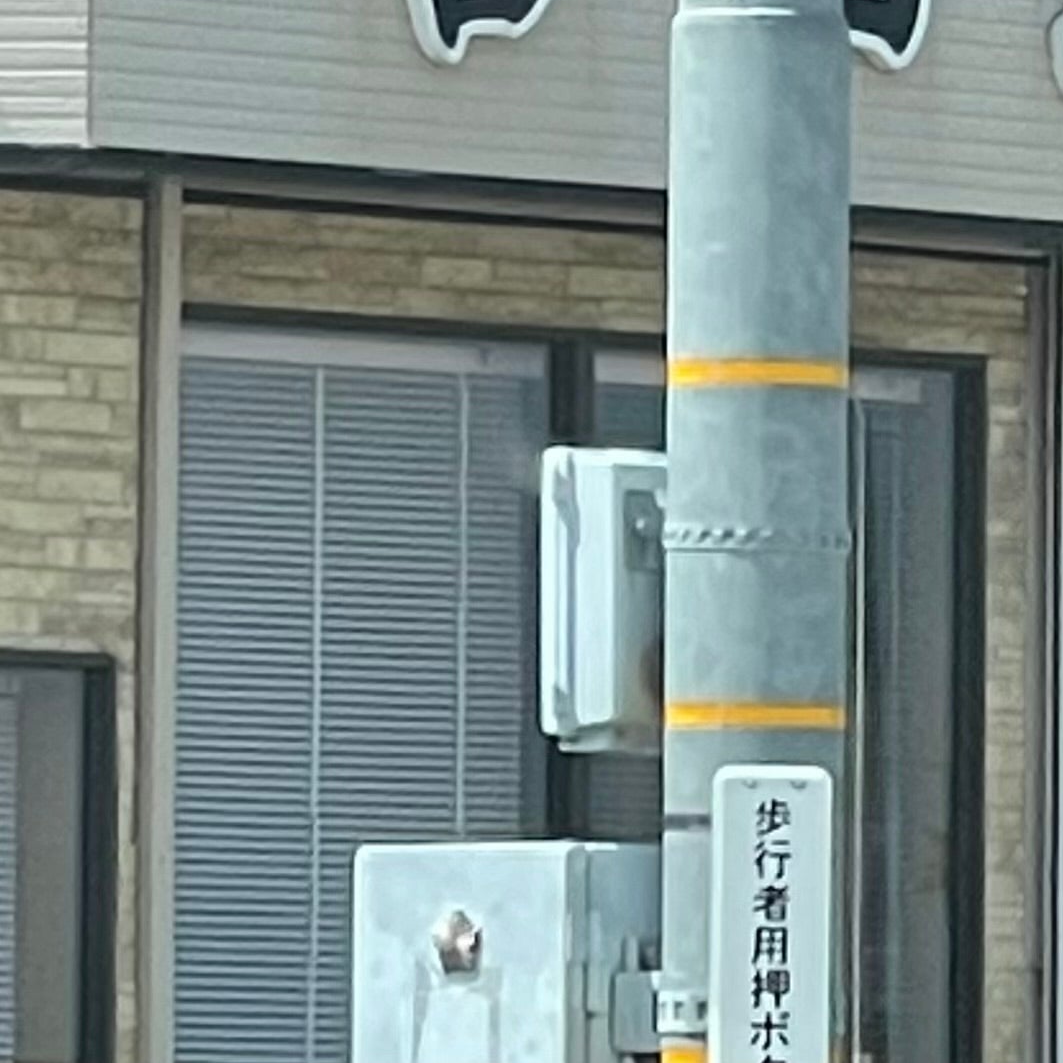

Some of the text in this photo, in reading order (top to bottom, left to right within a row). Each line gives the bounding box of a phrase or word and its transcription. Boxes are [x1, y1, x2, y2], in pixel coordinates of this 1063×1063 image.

[750, 798, 791, 1063] 歩行者用押ボ
